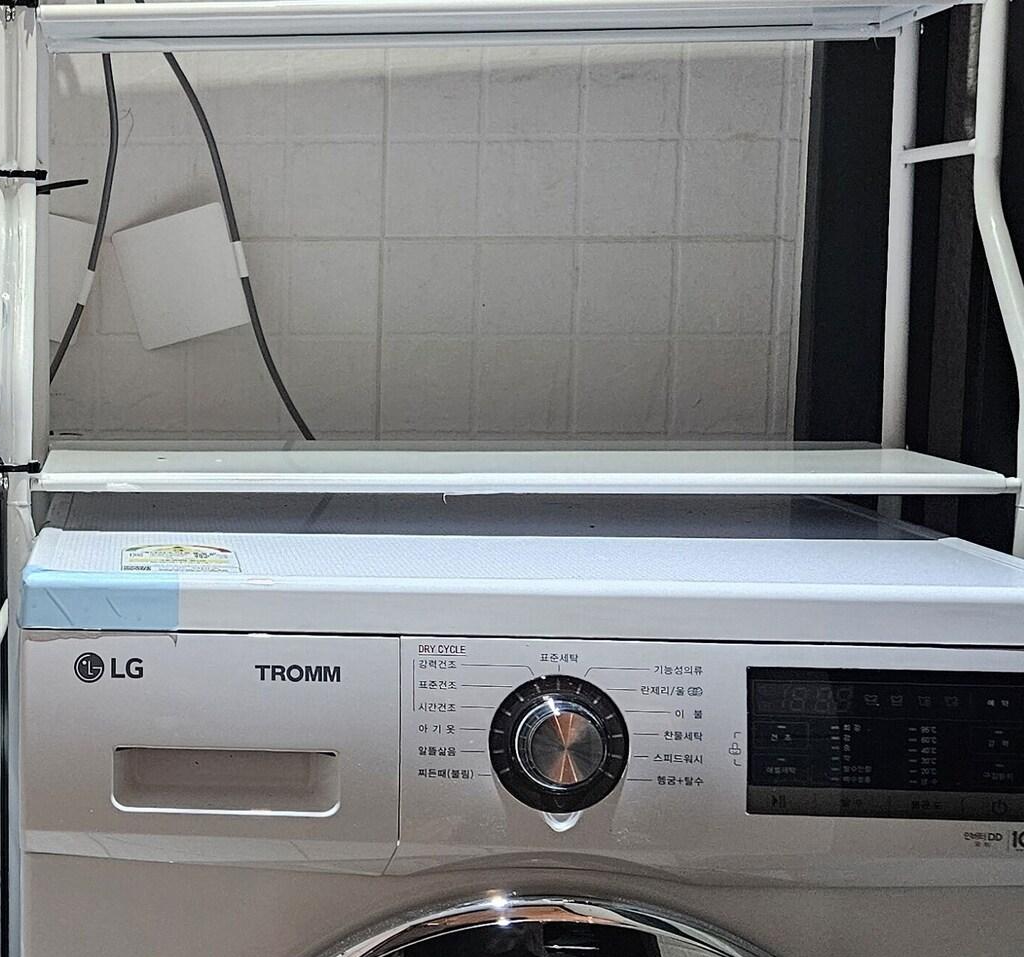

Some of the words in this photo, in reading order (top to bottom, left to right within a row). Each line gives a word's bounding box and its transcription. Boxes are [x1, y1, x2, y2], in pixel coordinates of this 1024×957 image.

[418, 644, 436, 654] DRY
[437, 644, 466, 654] CYCLE
[539, 653, 579, 663] 표준세탁
[110, 657, 144, 679] LG
[418, 660, 457, 669] 강력건조
[254, 664, 341, 683] TROMM
[653, 665, 704, 675] 기능성의류
[418, 680, 457, 689] 표준건조
[418, 702, 456, 712] 시간건조
[663, 730, 703, 741] 찬물세탁
[418, 746, 456, 757] 알뜰삶음
[653, 753, 704, 764] 스피드워시
[657, 775, 704, 786] 헹굼+탈수
